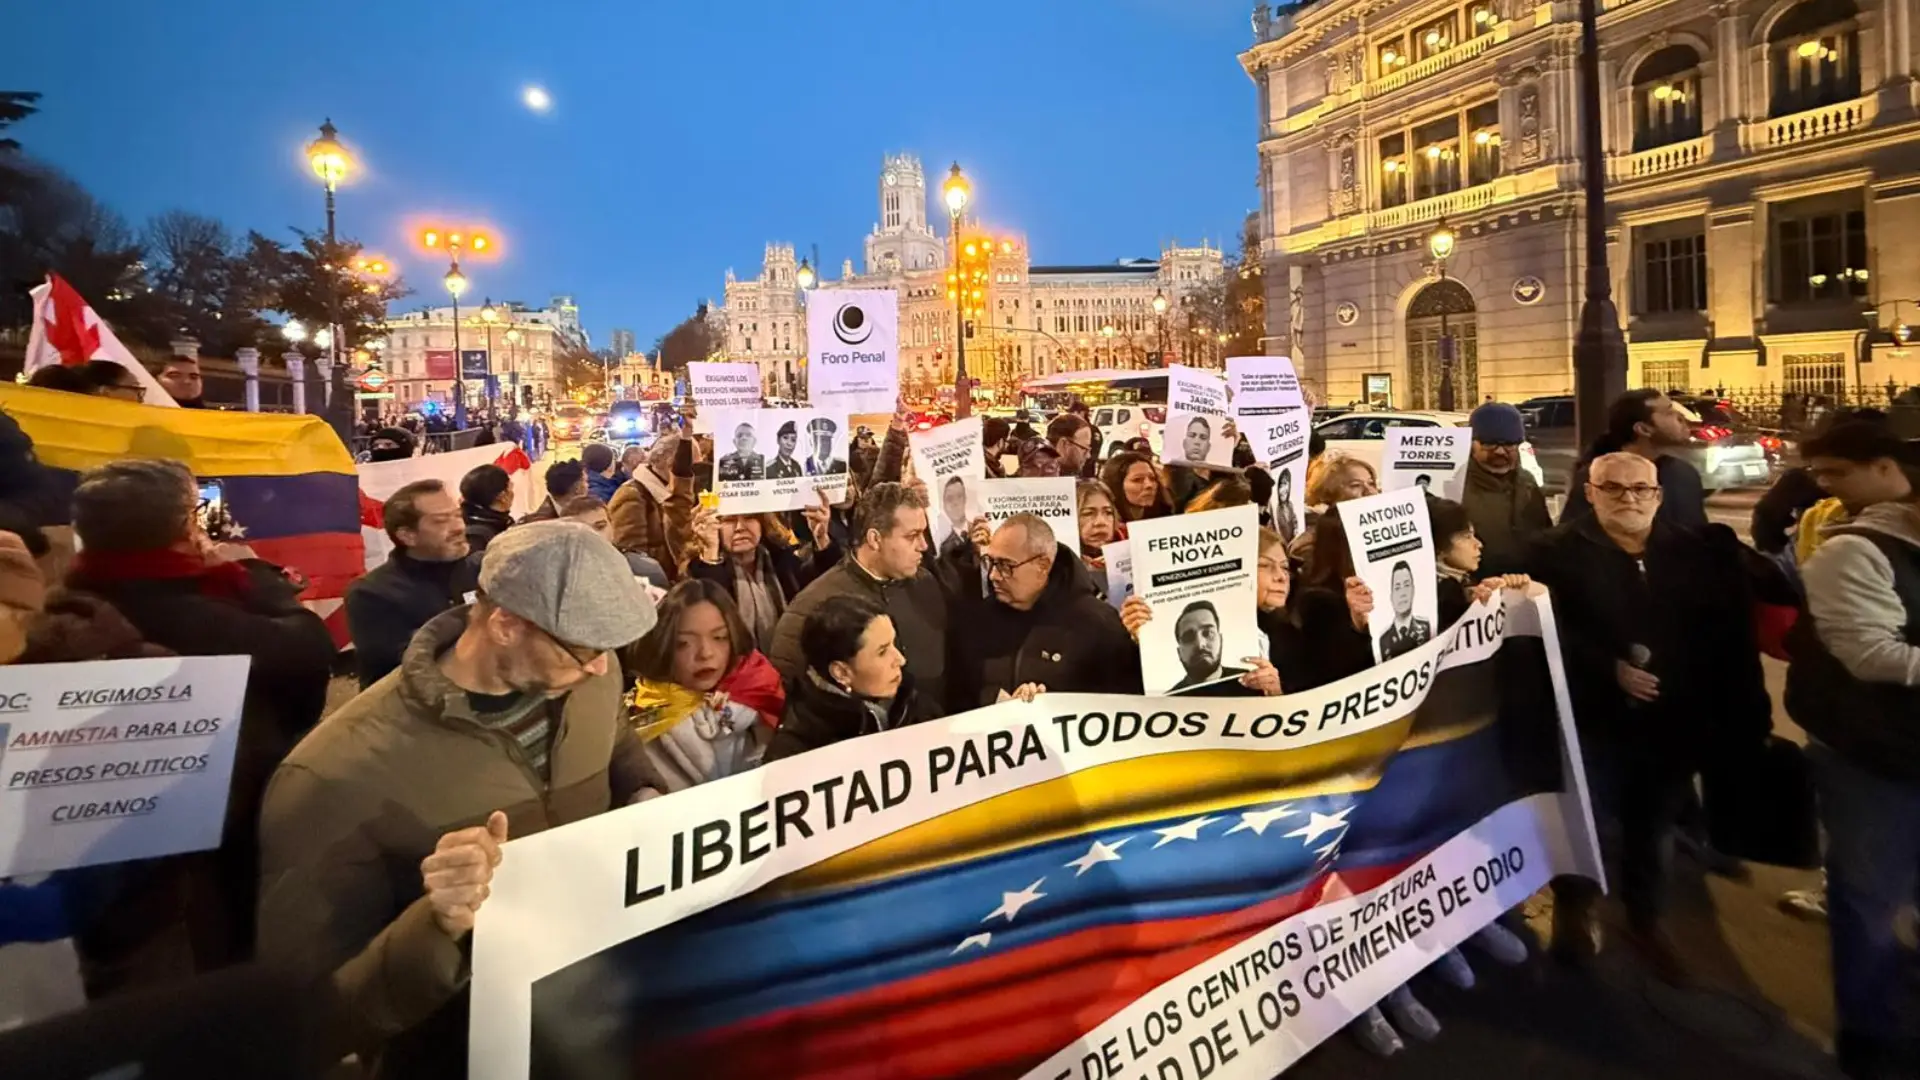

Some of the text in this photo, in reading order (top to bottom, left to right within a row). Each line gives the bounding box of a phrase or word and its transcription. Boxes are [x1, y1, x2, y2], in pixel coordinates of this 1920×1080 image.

[821, 350, 886, 365] Foro Penal
[705, 374, 748, 382] EXIGIMOS LOS
[695, 386, 728, 394] DERECHOS
[705, 398, 727, 406] TODOS
[728, 397, 740, 405] LOS
[1190, 395, 1214, 406] JAIRO
[1268, 420, 1300, 440] ZORIS
[1268, 436, 1304, 455] GUTIERREZ
[1401, 435, 1454, 446] MERYS
[1400, 450, 1451, 460] TORRES
[988, 494, 1069, 504] EXIGIMOS LIBERTAD
[992, 500, 1062, 510] INMEDIATA PARA
[1359, 502, 1414, 526] ANTONIO
[1148, 526, 1243, 552] FERNANDO
[1363, 520, 1417, 545] SEQUEA
[1172, 544, 1224, 564] NOYA
[1156, 567, 1202, 582] VENEZOLANO
[1208, 562, 1238, 573] ESPAÑOL
[57, 686, 164, 706] EXIGIMOS
[168, 684, 193, 699] LA
[9, 717, 221, 748] AMNISTIA PARA LOS
[9, 754, 210, 787] PRESOS POLITICOS
[624, 759, 911, 908] LIBERTAD
[929, 724, 1047, 793] PARA
[1052, 711, 1209, 753] TODOS
[1221, 709, 1310, 739] LOS
[1318, 661, 1430, 730] PRESOS
[51, 796, 159, 822] CUBANOS
[1082, 863, 1436, 1080] DE LOS CENTROS DE TORTURA
[1189, 846, 1525, 1080] DE LOS CRIMENES DE ODIO
